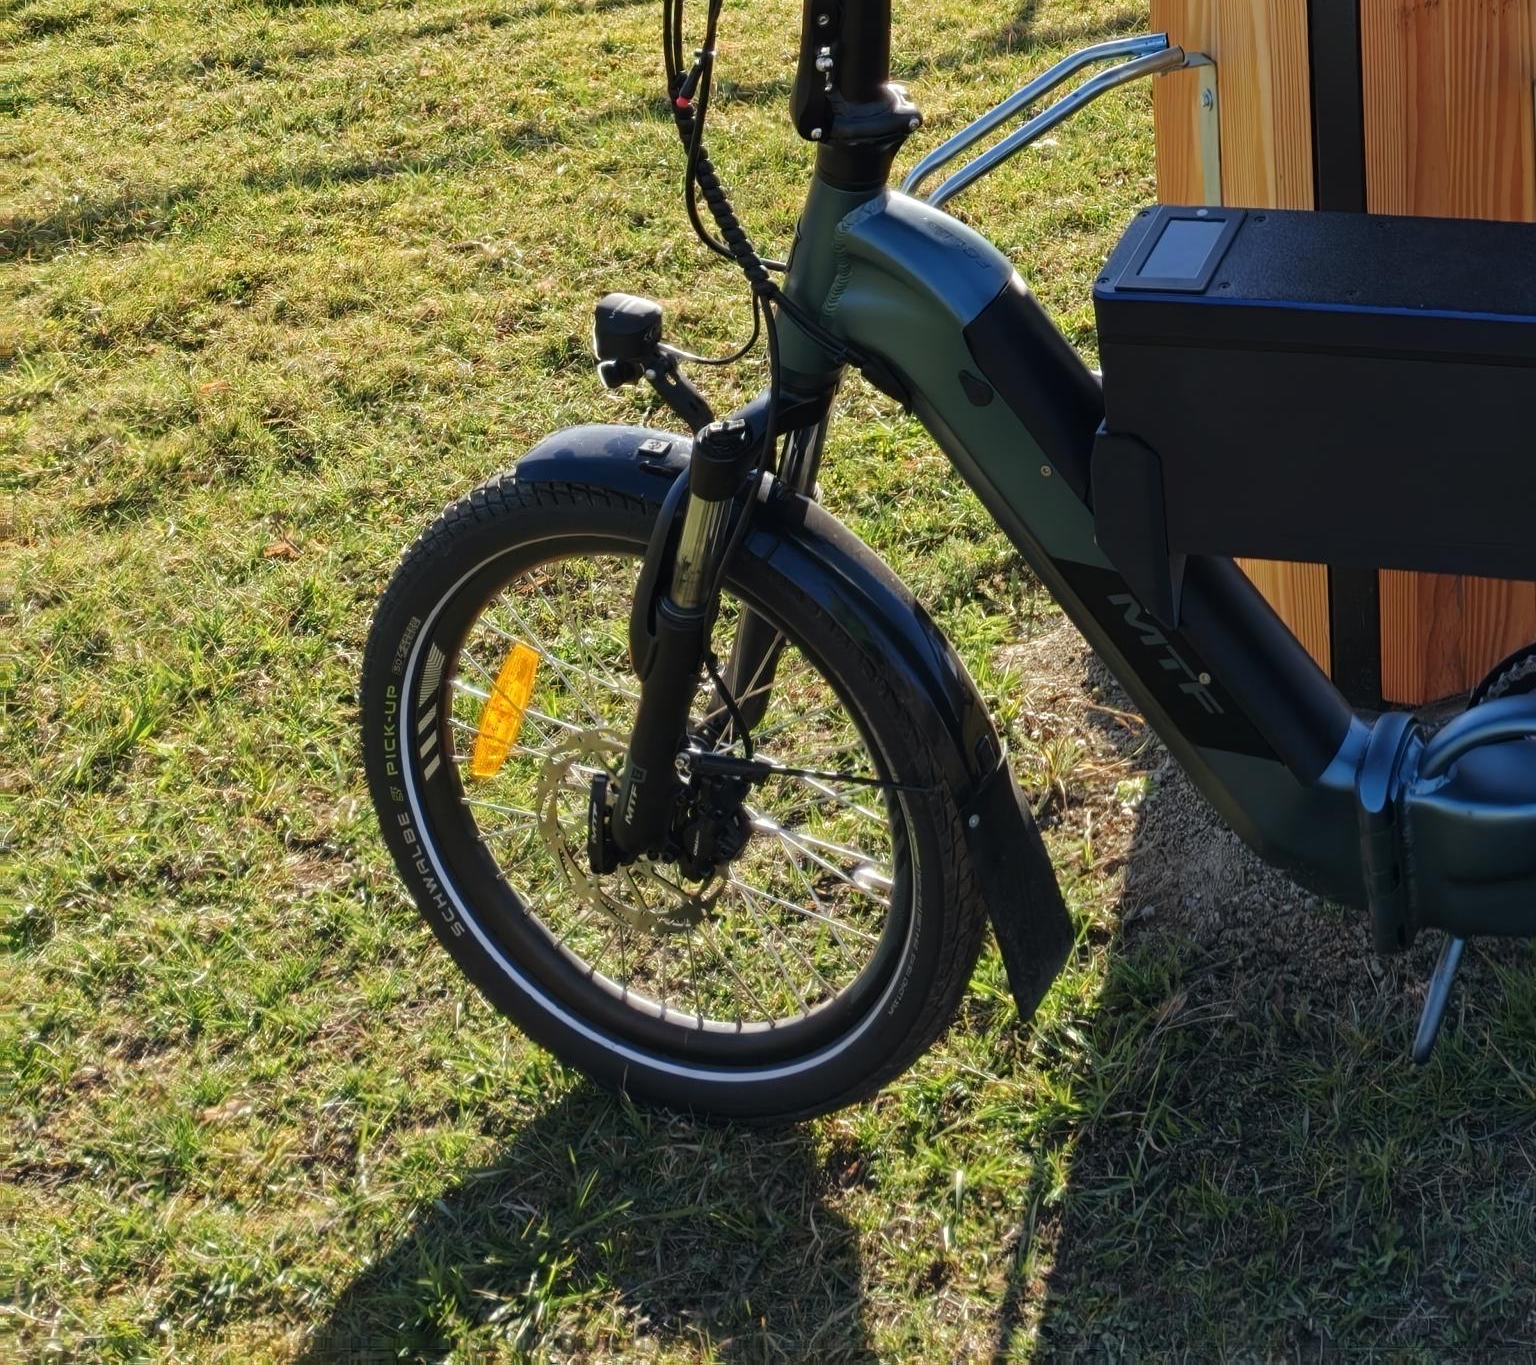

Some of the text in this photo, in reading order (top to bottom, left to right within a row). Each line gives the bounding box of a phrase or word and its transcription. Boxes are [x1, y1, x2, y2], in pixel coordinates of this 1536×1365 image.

[1107, 593, 1225, 715] MTF
[384, 685, 465, 937] SCHWALBE PICK-UP
